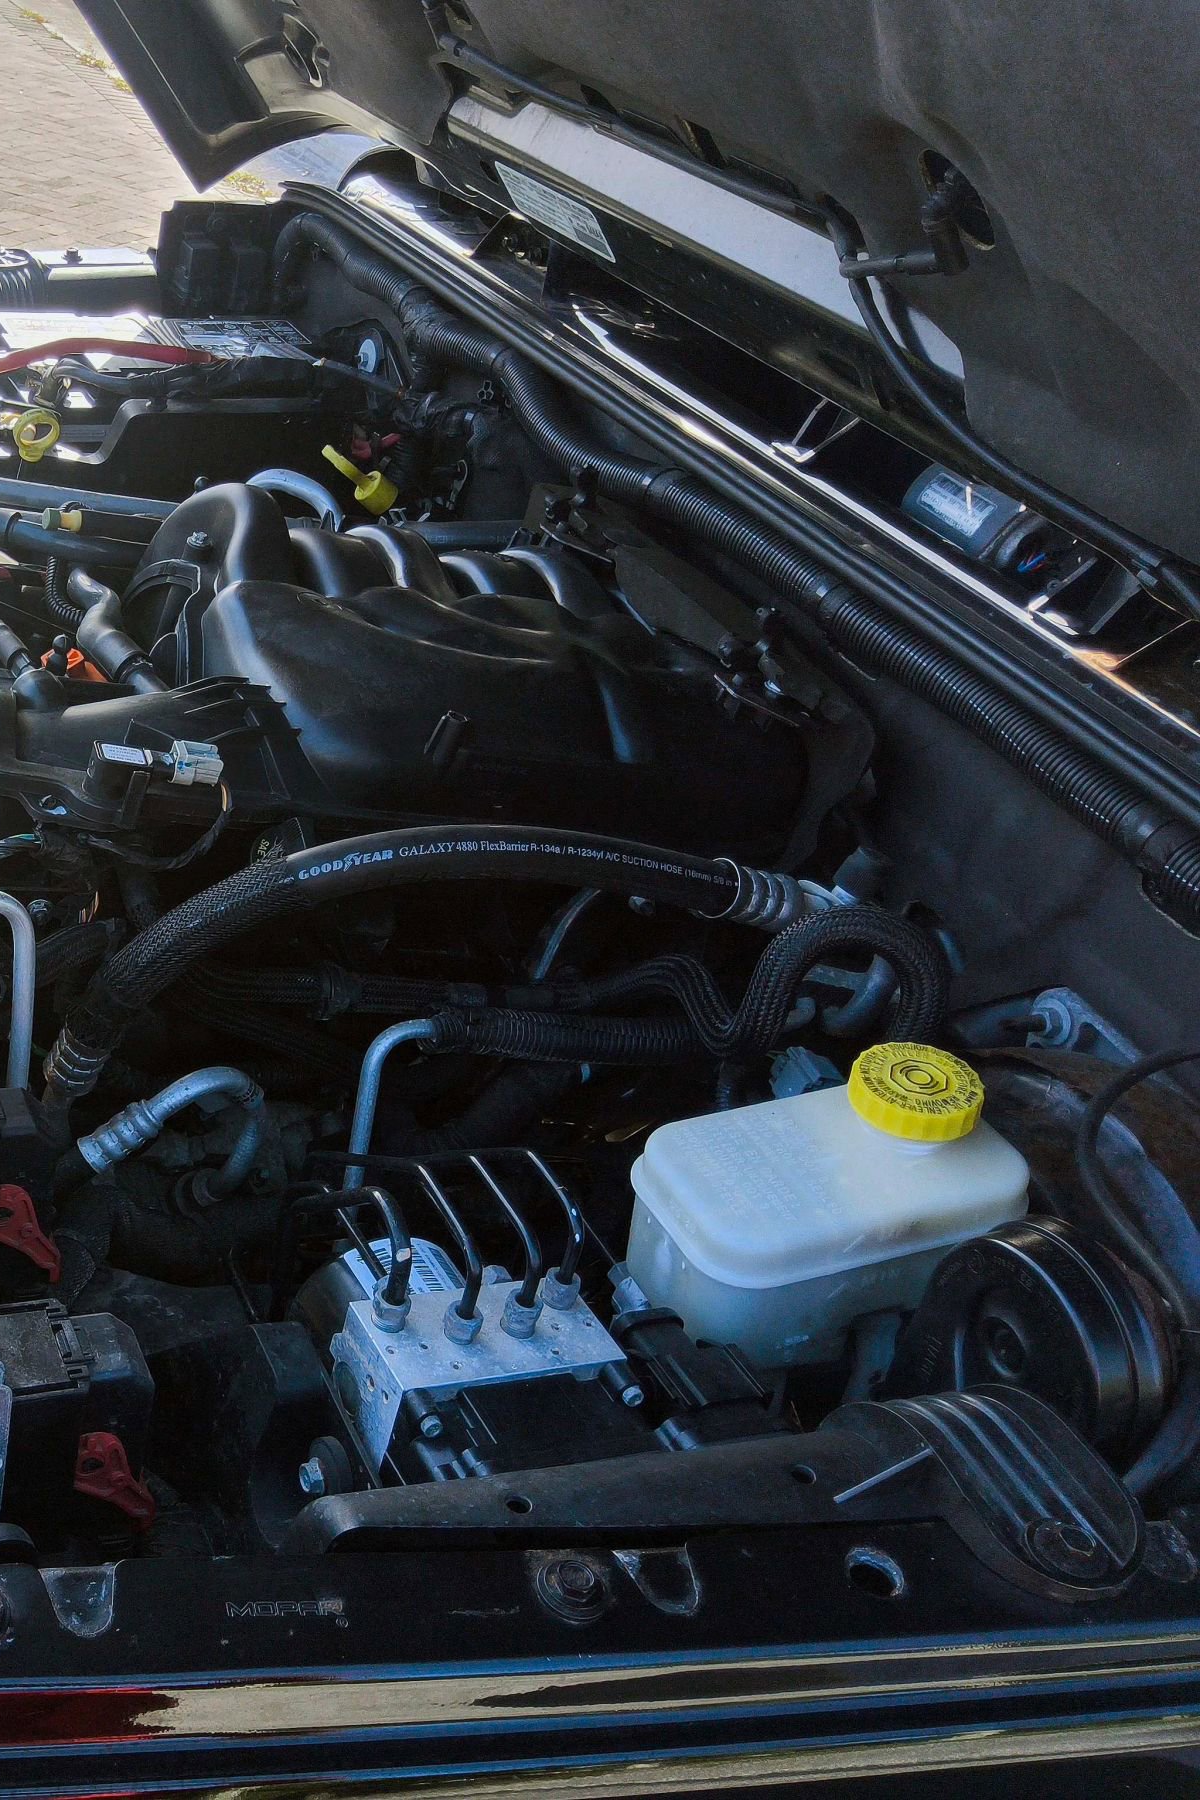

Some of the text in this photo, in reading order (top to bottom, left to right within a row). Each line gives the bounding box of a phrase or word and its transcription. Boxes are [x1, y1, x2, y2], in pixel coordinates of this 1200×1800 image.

[298, 850, 394, 880] GOODYEAR
[399, 842, 455, 857] GALAXY
[456, 841, 478, 851] 4880
[480, 841, 529, 852] FlexBarrier
[530, 843, 560, 854] R-134a
[605, 853, 620, 862] A/C
[621, 854, 659, 870] SUCTION
[660, 863, 683, 875] HOSE
[225, 1600, 345, 1617] MOPAR
